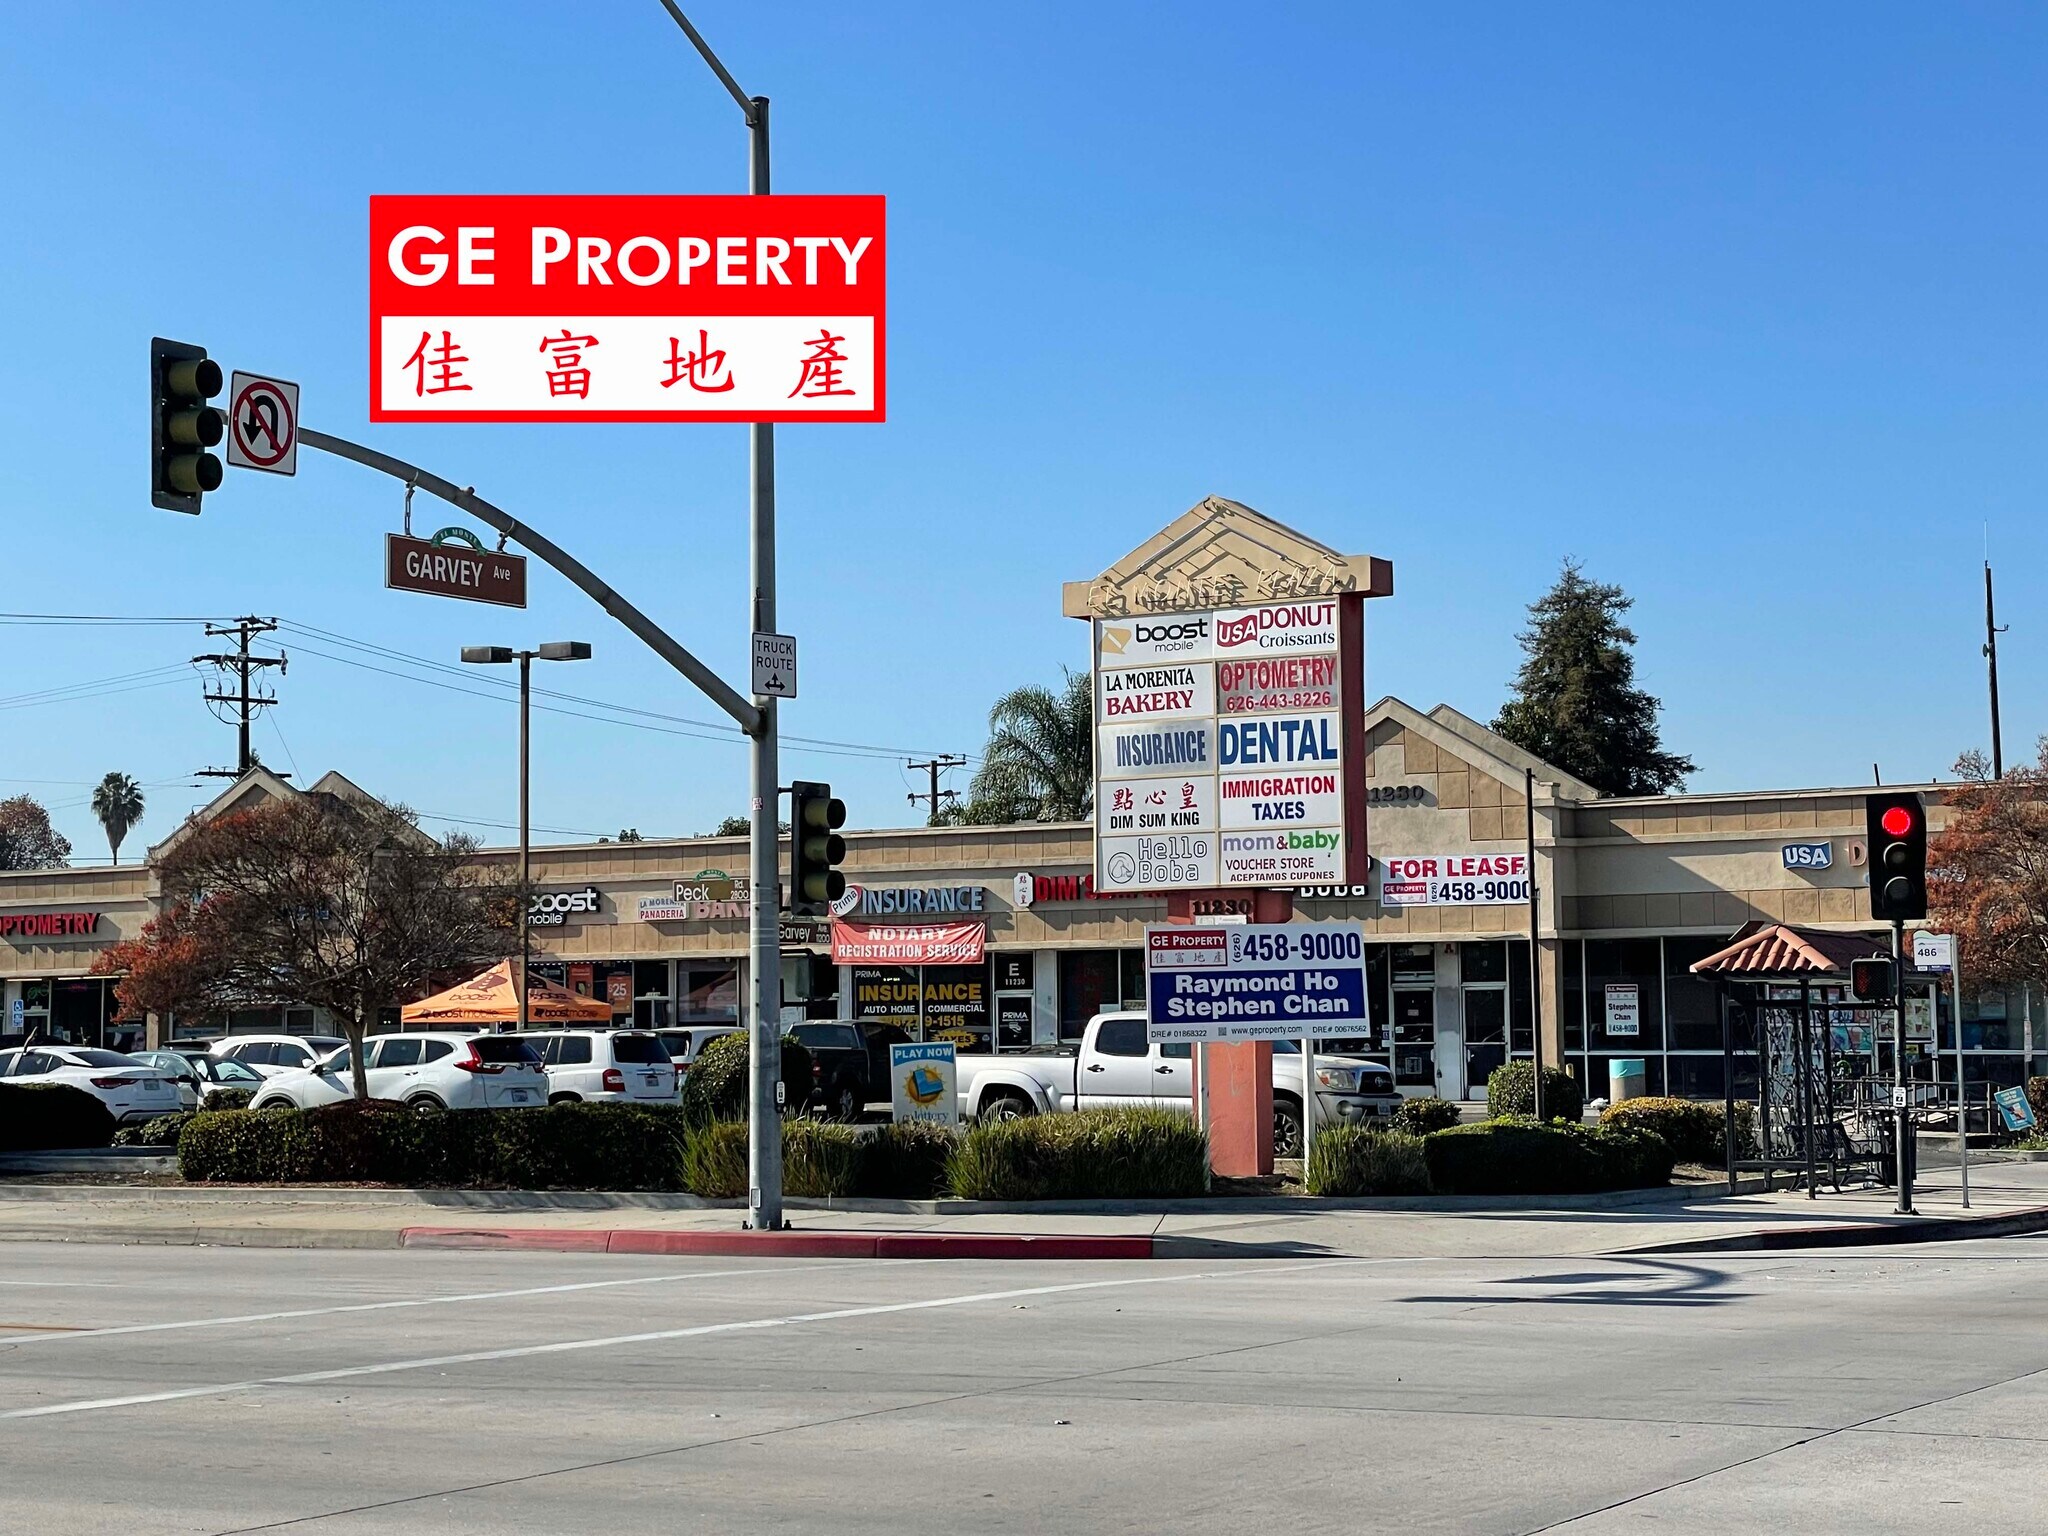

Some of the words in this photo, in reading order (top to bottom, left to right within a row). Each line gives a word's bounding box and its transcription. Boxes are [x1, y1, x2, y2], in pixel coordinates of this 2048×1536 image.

[406, 551, 483, 587] GARVEY
[493, 565, 511, 581] Ave
[1259, 604, 1336, 630] DONUT
[1135, 618, 1208, 643] boost
[1218, 619, 1256, 643] USA
[756, 639, 793, 655] TRUCK
[1154, 641, 1194, 652] mobile
[1260, 632, 1335, 648] Croissants
[756, 656, 793, 671] ROUTE
[1105, 675, 1122, 691] LA
[1125, 668, 1195, 690] MORENITA
[1220, 657, 1336, 692] OPTOMETRY
[1106, 690, 1194, 716] BAKERY
[1227, 691, 1331, 711] 626-443-8226
[1116, 731, 1206, 767] INSURANCE
[1219, 718, 1338, 765] DENTAL
[1222, 775, 1335, 799] IMMIGRATION
[1367, 785, 1424, 803] 1230
[1112, 782, 1198, 812] 點心皇
[1110, 815, 1133, 829] DIM
[1139, 813, 1166, 828] SUM
[1171, 811, 1200, 826] KING
[1252, 801, 1305, 821] TAXES
[1138, 836, 1208, 861] Hello
[1223, 830, 1340, 851] mom&baby
[1225, 859, 1276, 871] VOUCHER
[1280, 857, 1314, 869] STORE
[1785, 847, 1828, 865] USA
[1138, 860, 1199, 884] Boba
[1230, 872, 1287, 882] ACEPTAMOS
[1290, 871, 1335, 881] CUPONES
[1389, 859, 1438, 879] FOR
[1447, 856, 1526, 877] LEASE
[676, 884, 709, 901] Peck
[730, 890, 749, 900] 2800
[1035, 875, 1078, 901] DIM
[1384, 885, 1395, 893] GE
[640, 900, 647, 909] LA
[833, 889, 857, 913] Prima
[862, 886, 984, 915] INSURANCE
[1193, 899, 1252, 916] 11230
[640, 909, 684, 919] PANADERIA
[0, 913, 98, 936] PTOMETRY
[779, 924, 810, 943] Garvey
[868, 927, 948, 941] NOTARY
[1151, 935, 1169, 947] GE
[1172, 935, 1225, 947] PROPERTY
[838, 944, 922, 957] REGISTRATION
[927, 943, 978, 957] SERVICE
[1231, 933, 1243, 963] (626)
[1243, 932, 1361, 962] 458-9000
[1917, 948, 1937, 957] 486
[1009, 963, 1020, 977] E
[608, 984, 627, 997] $25
[1005, 978, 1026, 986] 11230
[1175, 973, 1295, 997] Raymond
[1303, 972, 1339, 991] Ho
[858, 984, 982, 1002] INSURANCE
[864, 1005, 887, 1014] AUTO
[890, 1005, 916, 1013] HOME
[927, 1005, 985, 1013] COMMERCIAL
[1002, 1011, 1028, 1019] PRIMA
[1167, 997, 1276, 1019] Stephen
[1283, 995, 1349, 1014] Chan
[1608, 1003, 1637, 1011] Stephen
[1614, 1013, 1632, 1021] Chan
[1151, 1030, 1172, 1038] DRE#
[1231, 1025, 1303, 1035] www.geproperty.com
[1312, 1026, 1333, 1034] DRE#
[894, 1049, 923, 1059] PLAY
[927, 1048, 952, 1057] NOW
